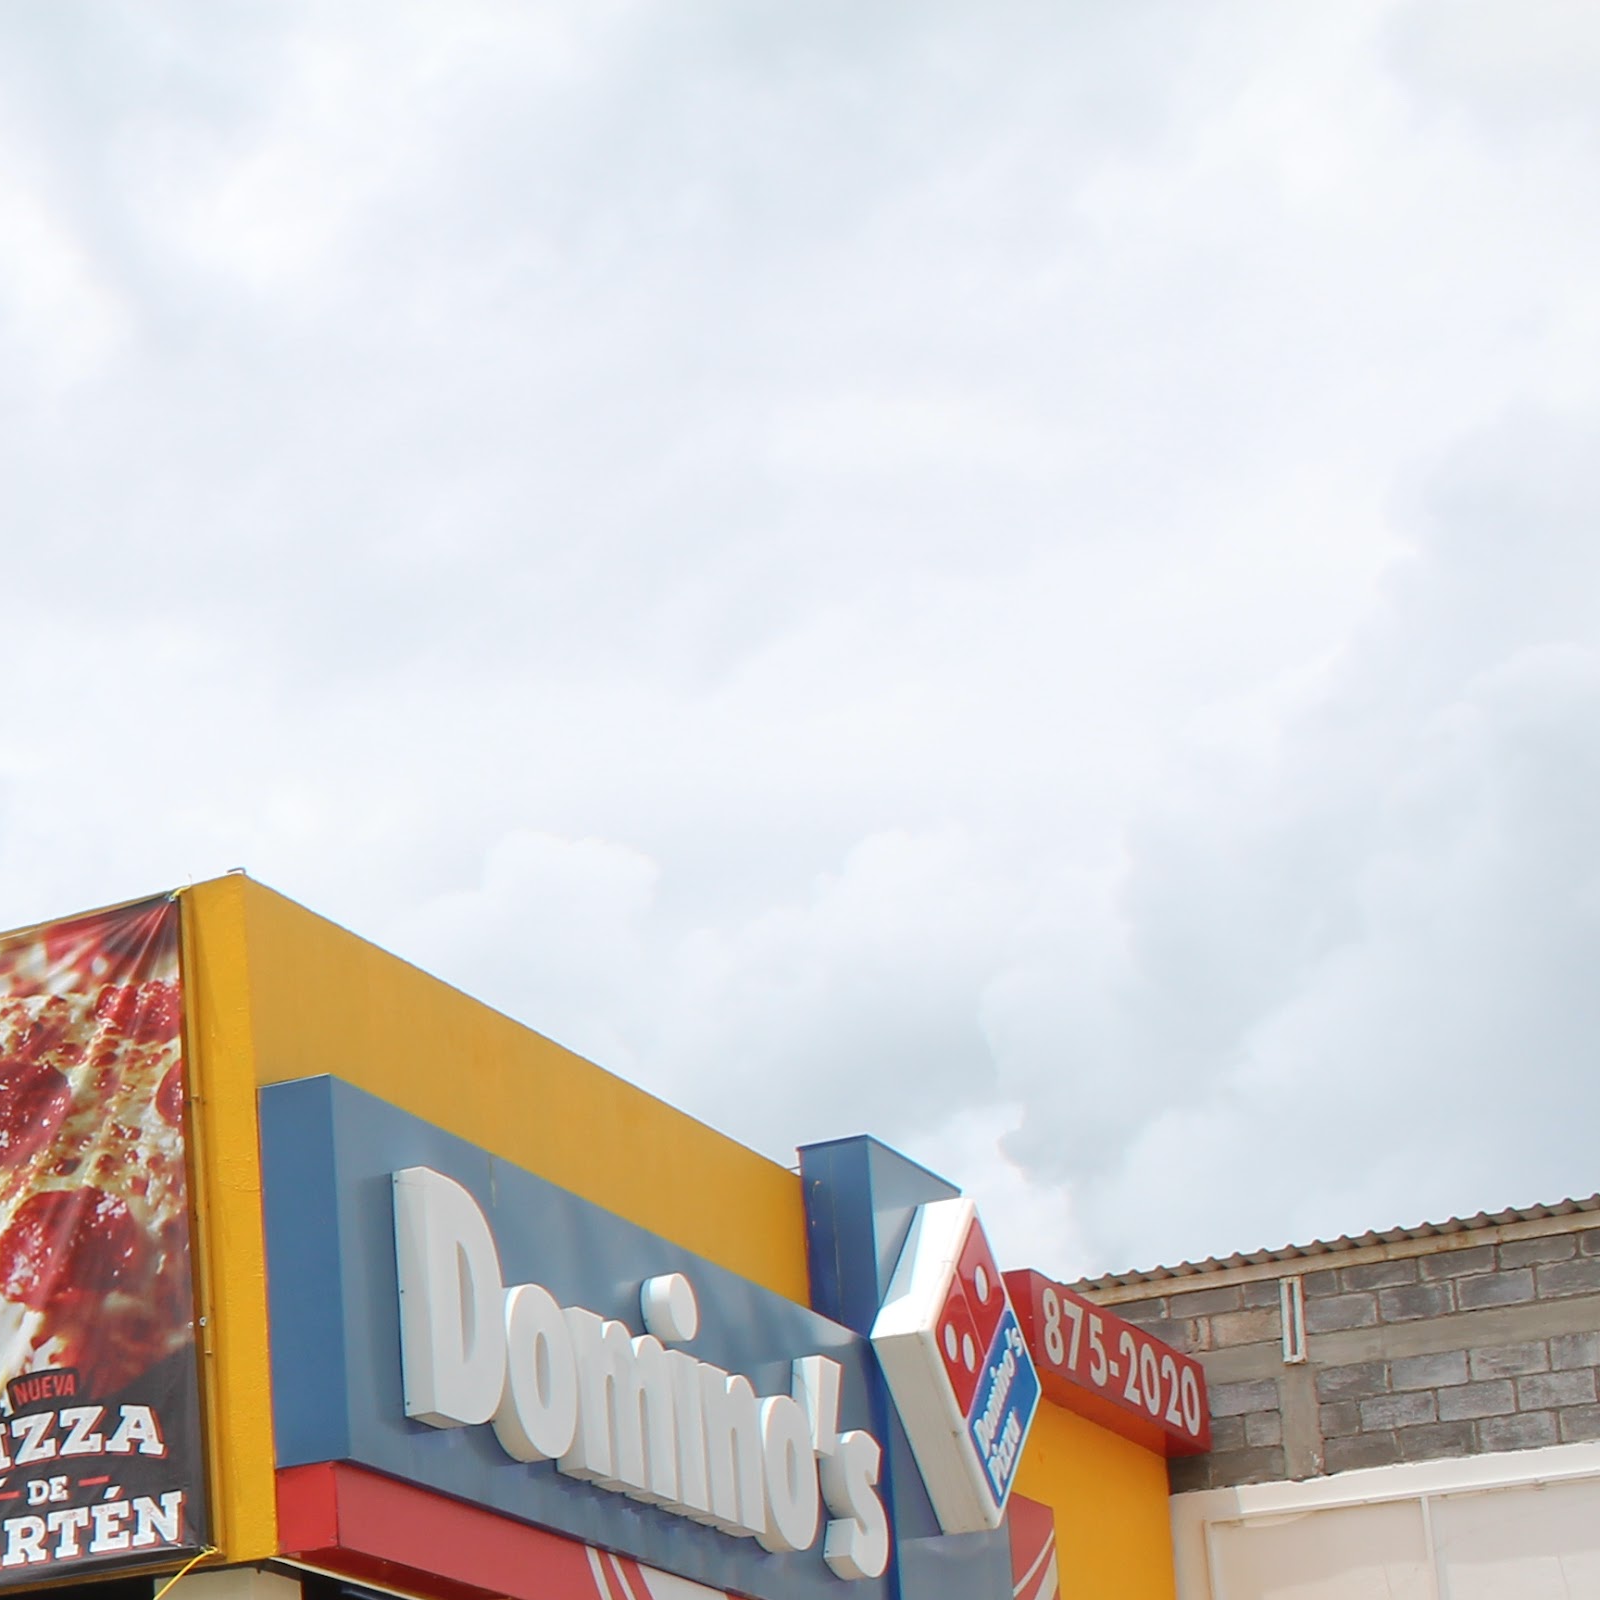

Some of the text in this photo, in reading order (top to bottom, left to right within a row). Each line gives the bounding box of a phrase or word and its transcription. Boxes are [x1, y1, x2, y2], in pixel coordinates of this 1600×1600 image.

[13, 1373, 75, 1405] NUEVA
[390, 1165, 889, 1580] Domino's
[973, 1326, 1024, 1460] Domino's
[1043, 1288, 1200, 1436] 875-2020
[27, 1475, 69, 1506] DE
[987, 1411, 1022, 1497] Pizza
